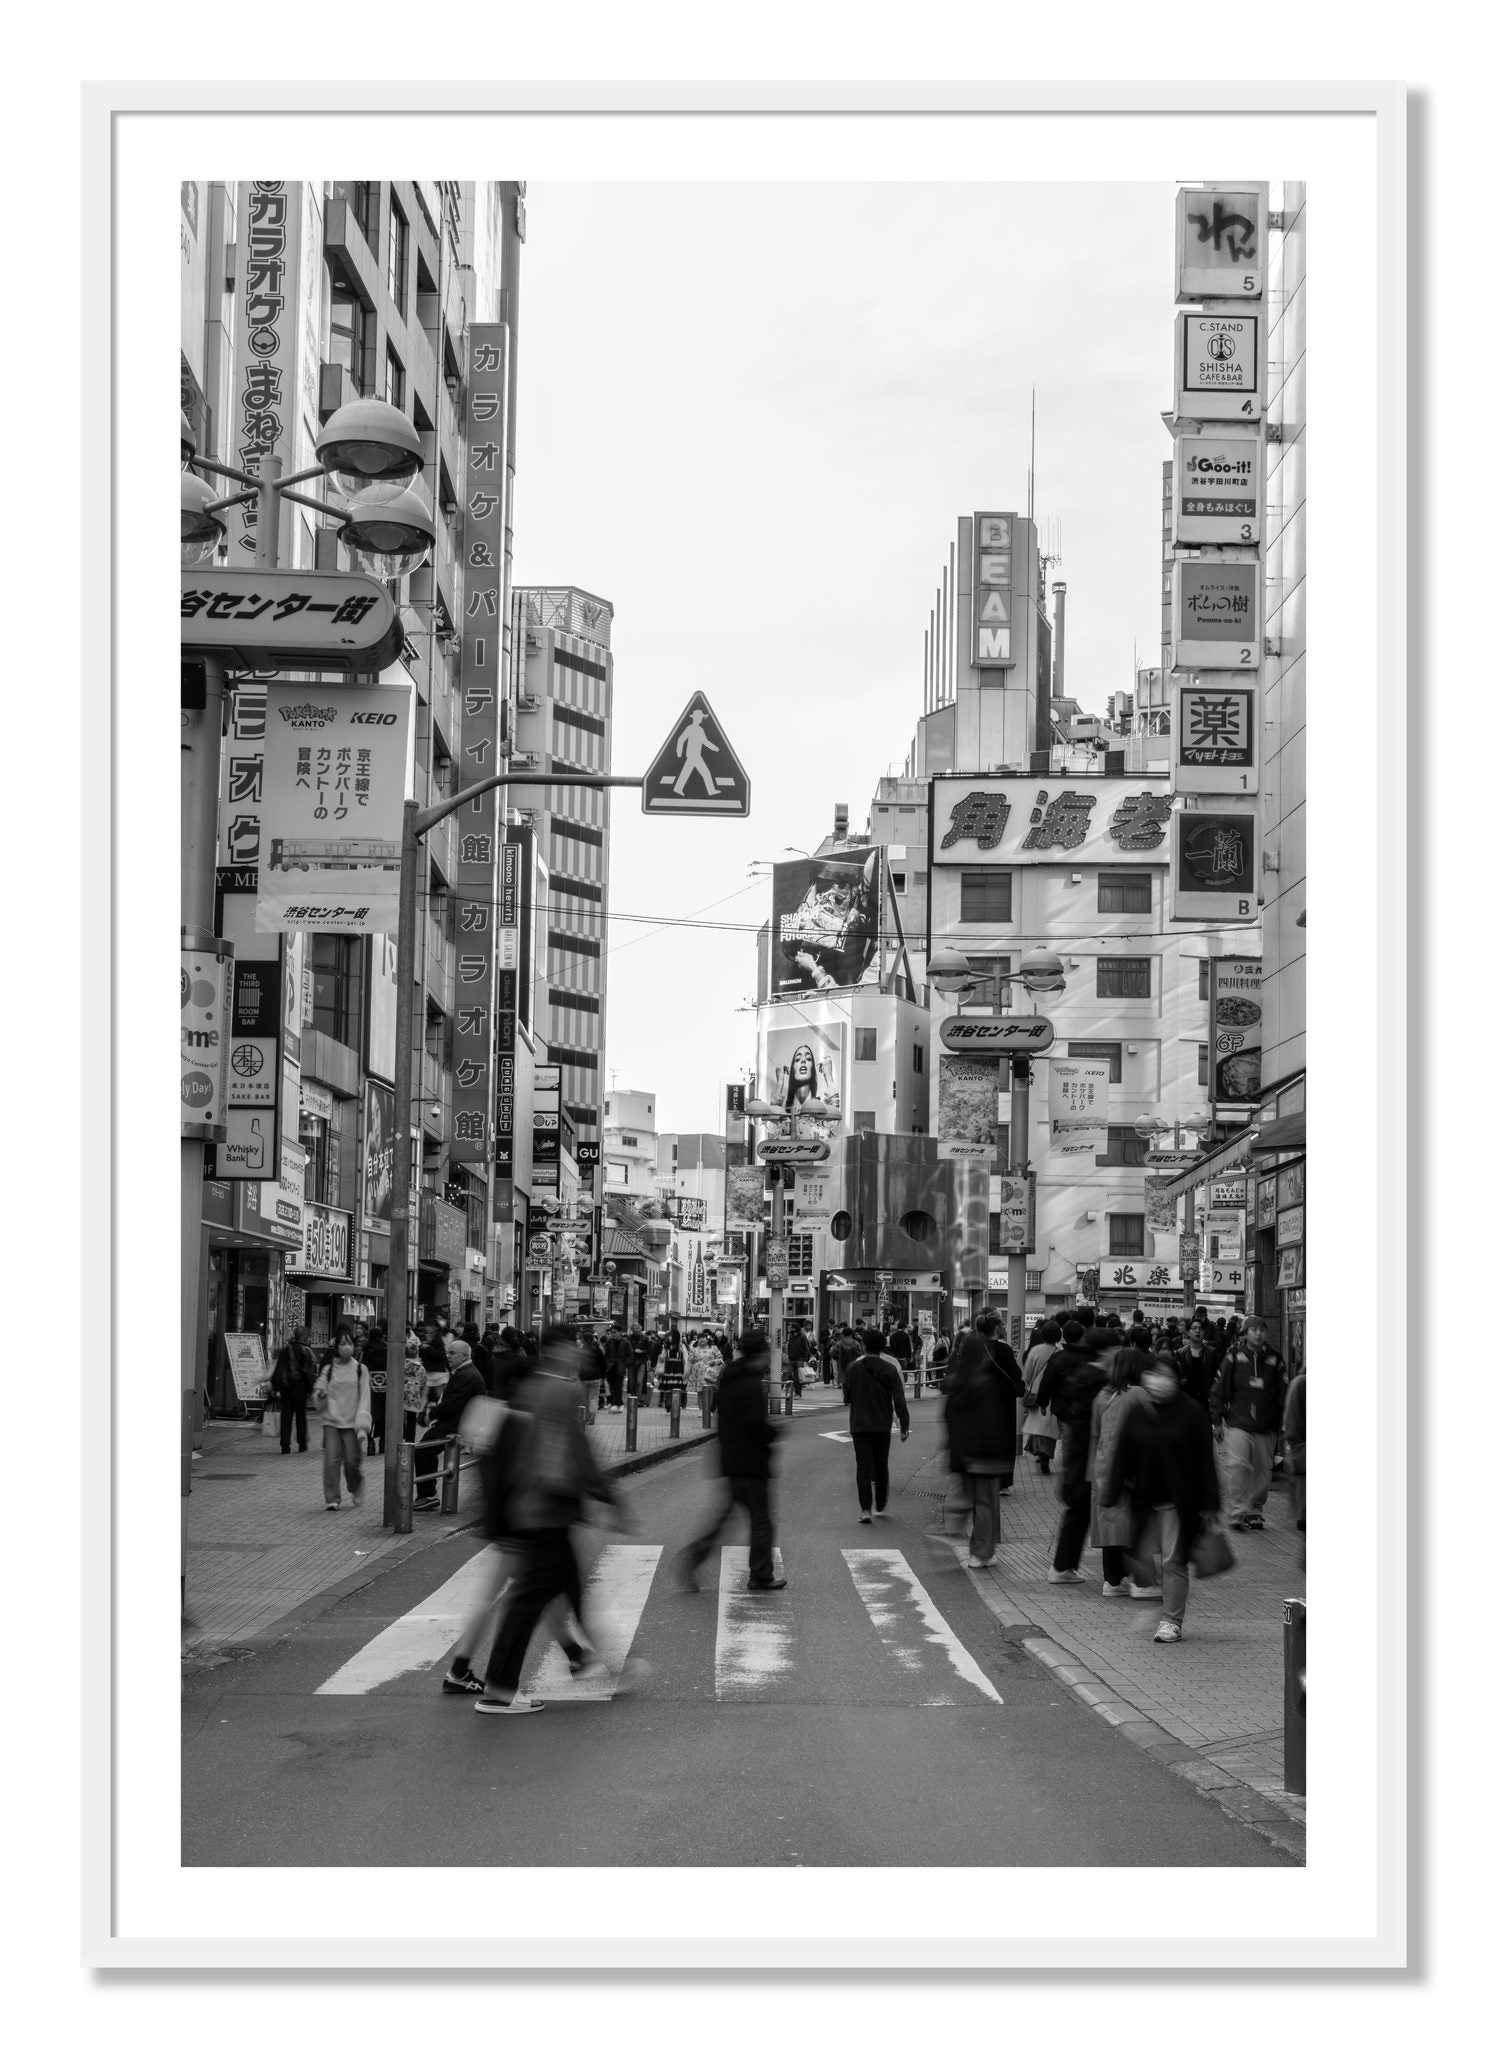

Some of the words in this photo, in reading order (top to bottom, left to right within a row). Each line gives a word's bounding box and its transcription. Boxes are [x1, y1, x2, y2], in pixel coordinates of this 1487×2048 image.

[247, 193, 286, 327] カラオケ
[1243, 276, 1254, 291] 5
[1199, 322, 1244, 332] C.STAND
[1199, 362, 1243, 373] SHISHA
[1199, 373, 1243, 382] CAFE&BAR
[1241, 399, 1253, 415] 4
[1198, 458, 1251, 473] Goo-it!
[1191, 477, 1248, 486] 渋谷宇田川町店
[1186, 501, 1252, 513] 全身もみほぐし
[1240, 524, 1252, 540] 3
[978, 516, 1011, 660] BEAM
[1240, 648, 1251, 664] 2
[291, 720, 325, 728] KANTO
[350, 712, 398, 725] KEIO
[1190, 696, 1240, 746] 薬
[296, 747, 311, 789] 冒険へ
[313, 747, 331, 820] カントーの
[334, 748, 351, 820] ポケパーク
[355, 748, 371, 806] 京王線で
[1240, 774, 1247, 789] 1
[940, 790, 1172, 850] 角海老
[506, 849, 514, 883] kimono
[283, 906, 370, 919] 渋谷センター街
[1239, 899, 1249, 915] B
[1218, 977, 1261, 990] 四川料理
[947, 1024, 1048, 1038] 渋谷センター街
[1216, 1034, 1245, 1052] 6F
[193, 1082, 211, 1095] Day!
[226, 1144, 259, 1155] Whisky
[579, 1148, 598, 1158] GU
[760, 1145, 821, 1154] 渋谷センター街
[226, 1154, 246, 1162] Bank
